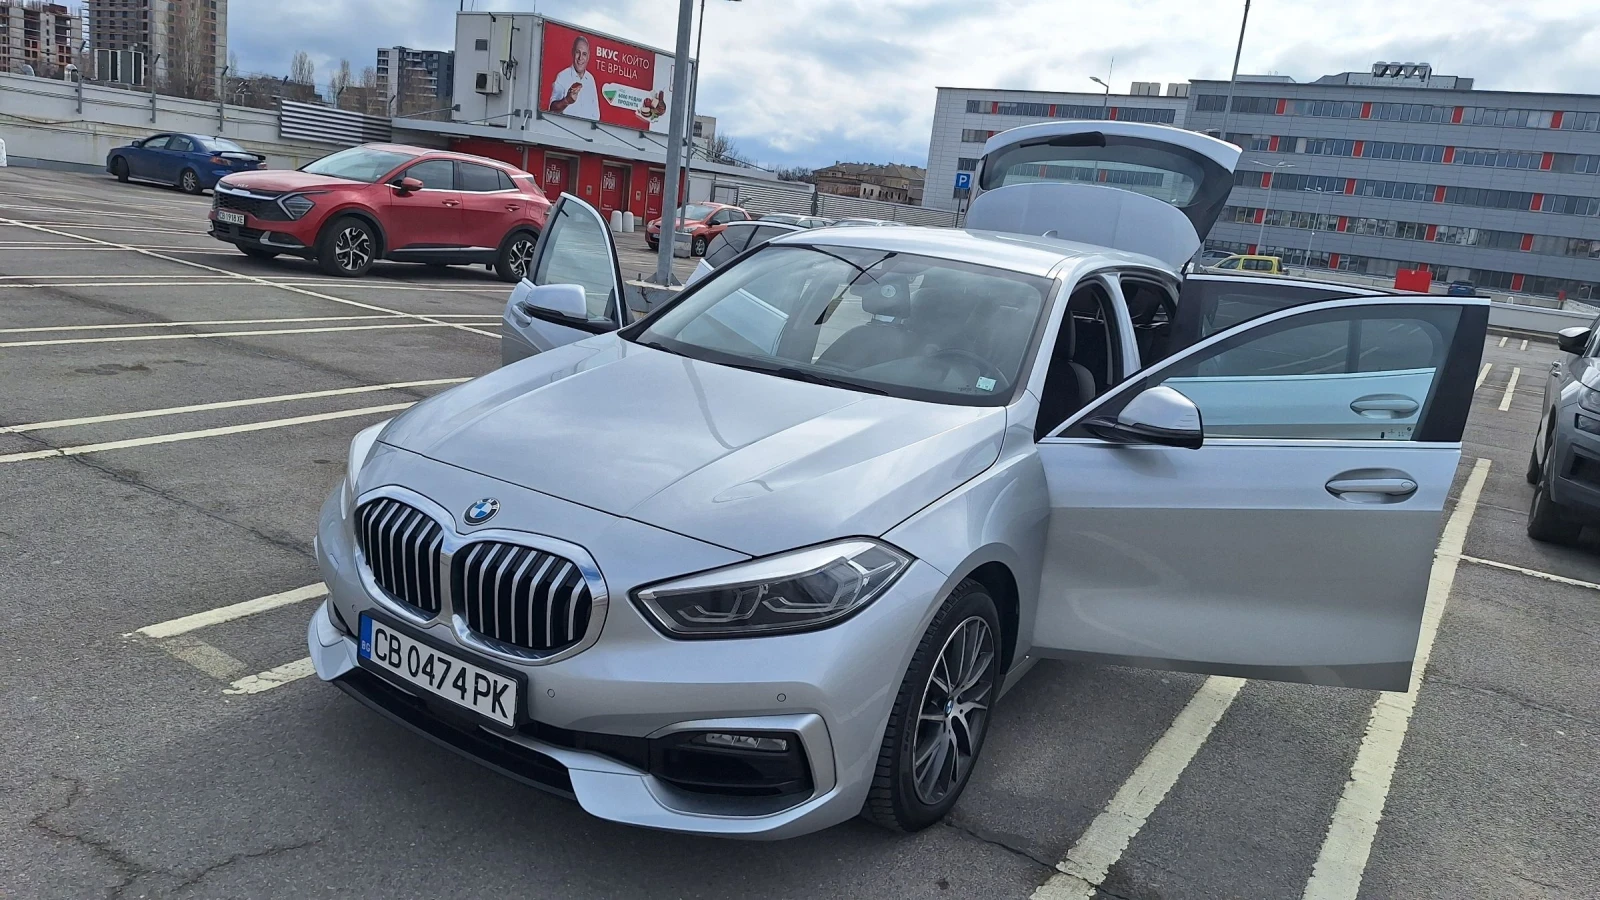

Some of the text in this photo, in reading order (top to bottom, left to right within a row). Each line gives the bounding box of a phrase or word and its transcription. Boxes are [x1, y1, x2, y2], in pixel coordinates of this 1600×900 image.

[596, 60, 638, 80] ТЕ ВРЪЩА
[622, 53, 650, 70] КОЙТО
[361, 640, 371, 653] BG
[374, 628, 510, 720] CB 0474 PK
